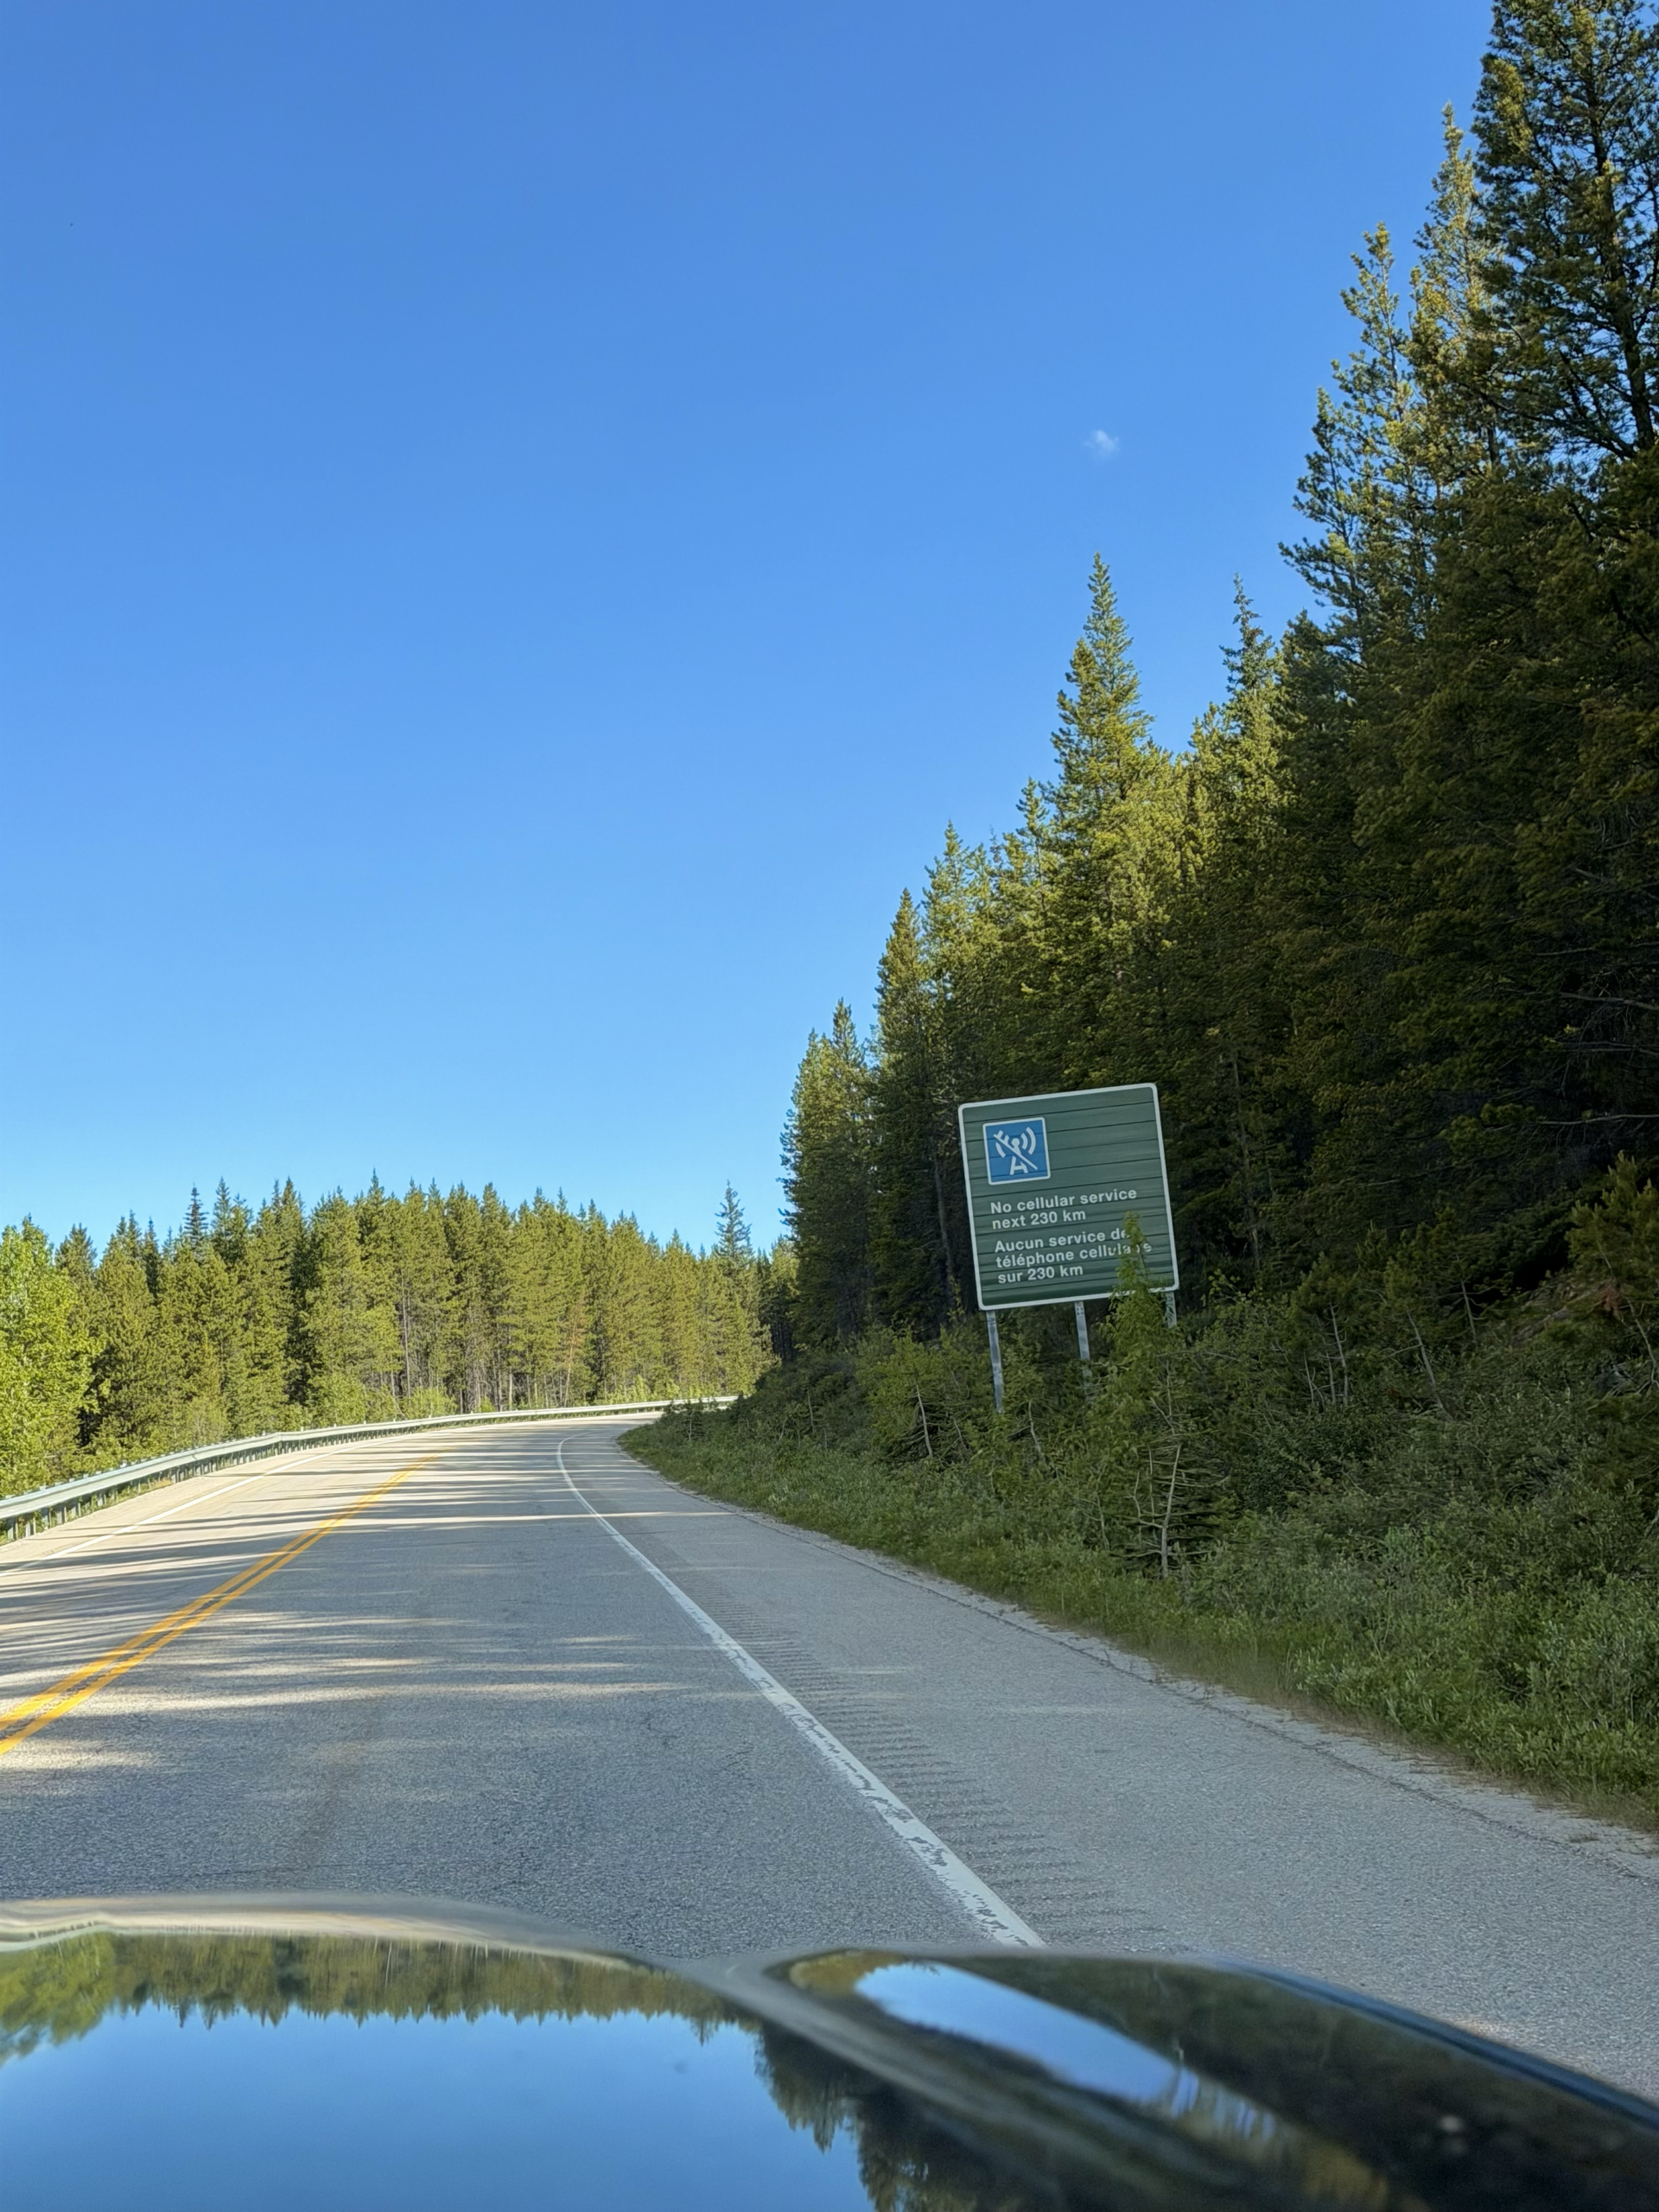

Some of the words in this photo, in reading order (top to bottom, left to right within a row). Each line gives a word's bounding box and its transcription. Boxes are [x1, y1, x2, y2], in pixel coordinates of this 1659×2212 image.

[990, 1202, 1012, 1214] No
[1017, 1197, 1075, 1211] cellular
[1080, 1188, 1137, 1205] service
[993, 1218, 1026, 1230] next
[1031, 1211, 1058, 1225] 230
[1063, 1210, 1086, 1222] km
[995, 1238, 1044, 1253] Aucun
[1049, 1230, 1106, 1246] service
[995, 1252, 1074, 1268] téléphone
[998, 1272, 1023, 1284] sur
[1027, 1267, 1055, 1281] 230
[1059, 1265, 1084, 1277] km
